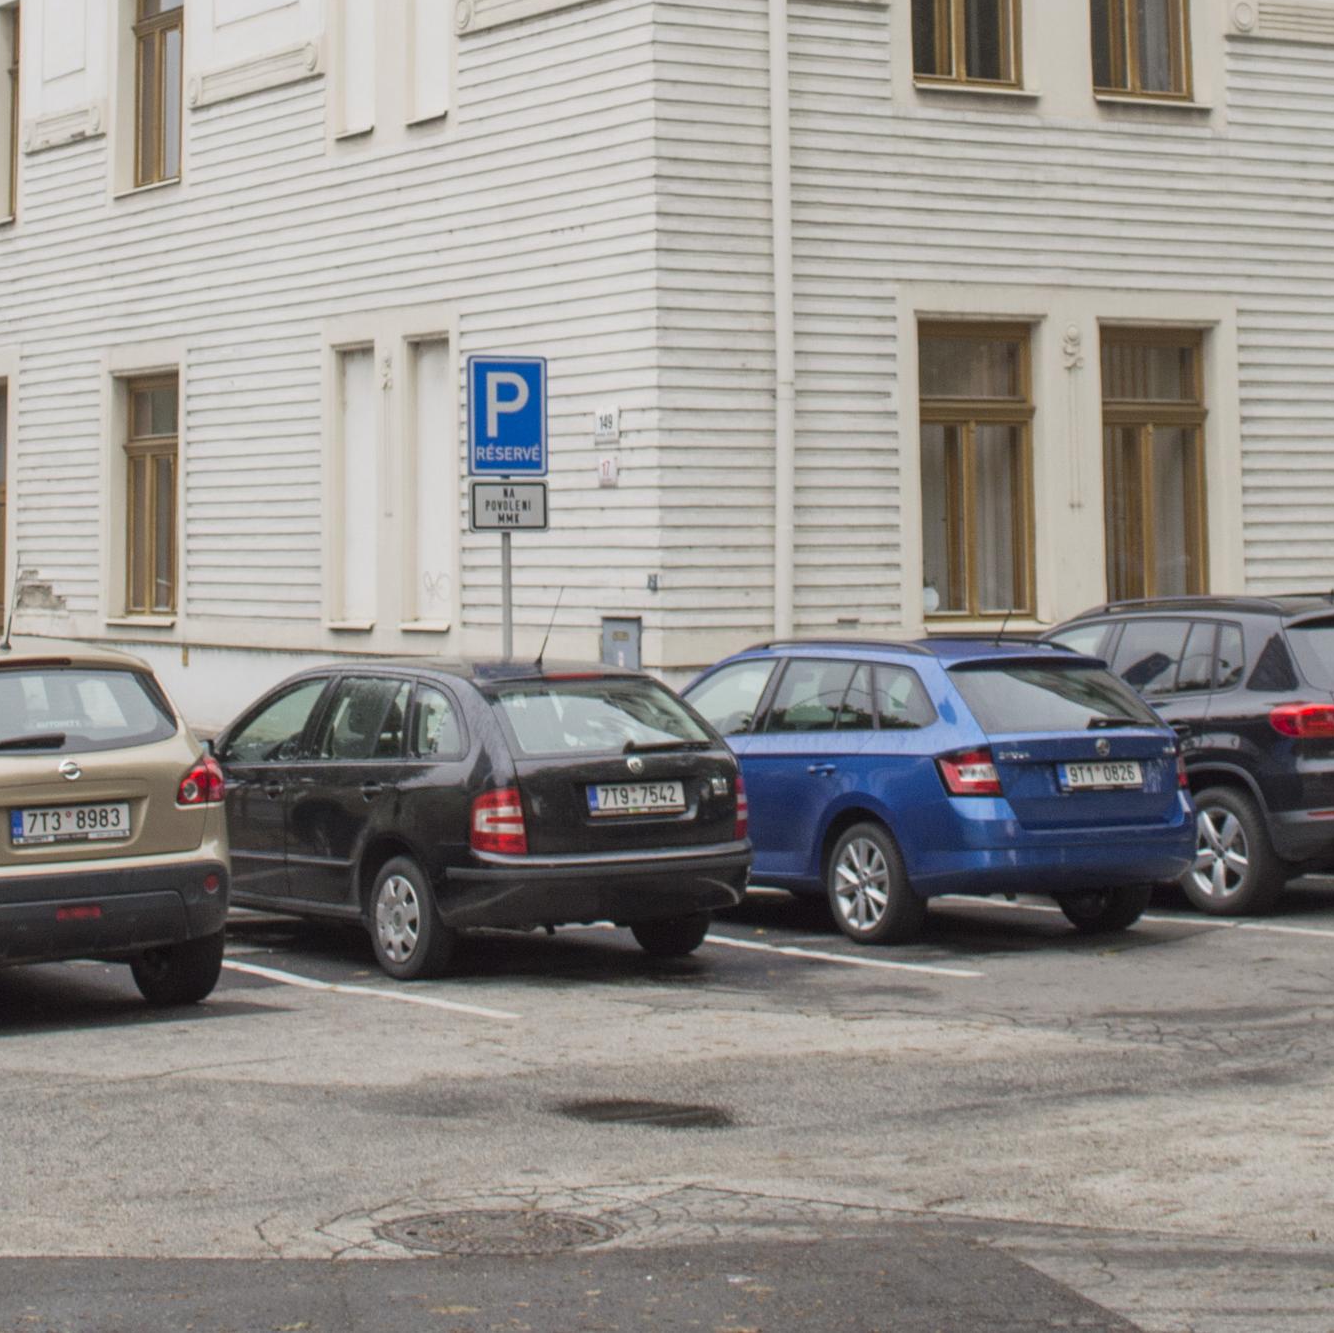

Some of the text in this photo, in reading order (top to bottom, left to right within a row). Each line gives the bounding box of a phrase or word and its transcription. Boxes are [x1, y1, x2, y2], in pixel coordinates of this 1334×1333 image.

[486, 371, 530, 438] P
[599, 413, 613, 430] 149
[476, 443, 541, 462] RÉSERVÉ
[503, 487, 516, 499] NA
[498, 513, 520, 524] MMK
[1069, 764, 1136, 783] 9T1 0826
[600, 785, 677, 807] 7T9 7542
[27, 808, 121, 833] 7T3 8983
